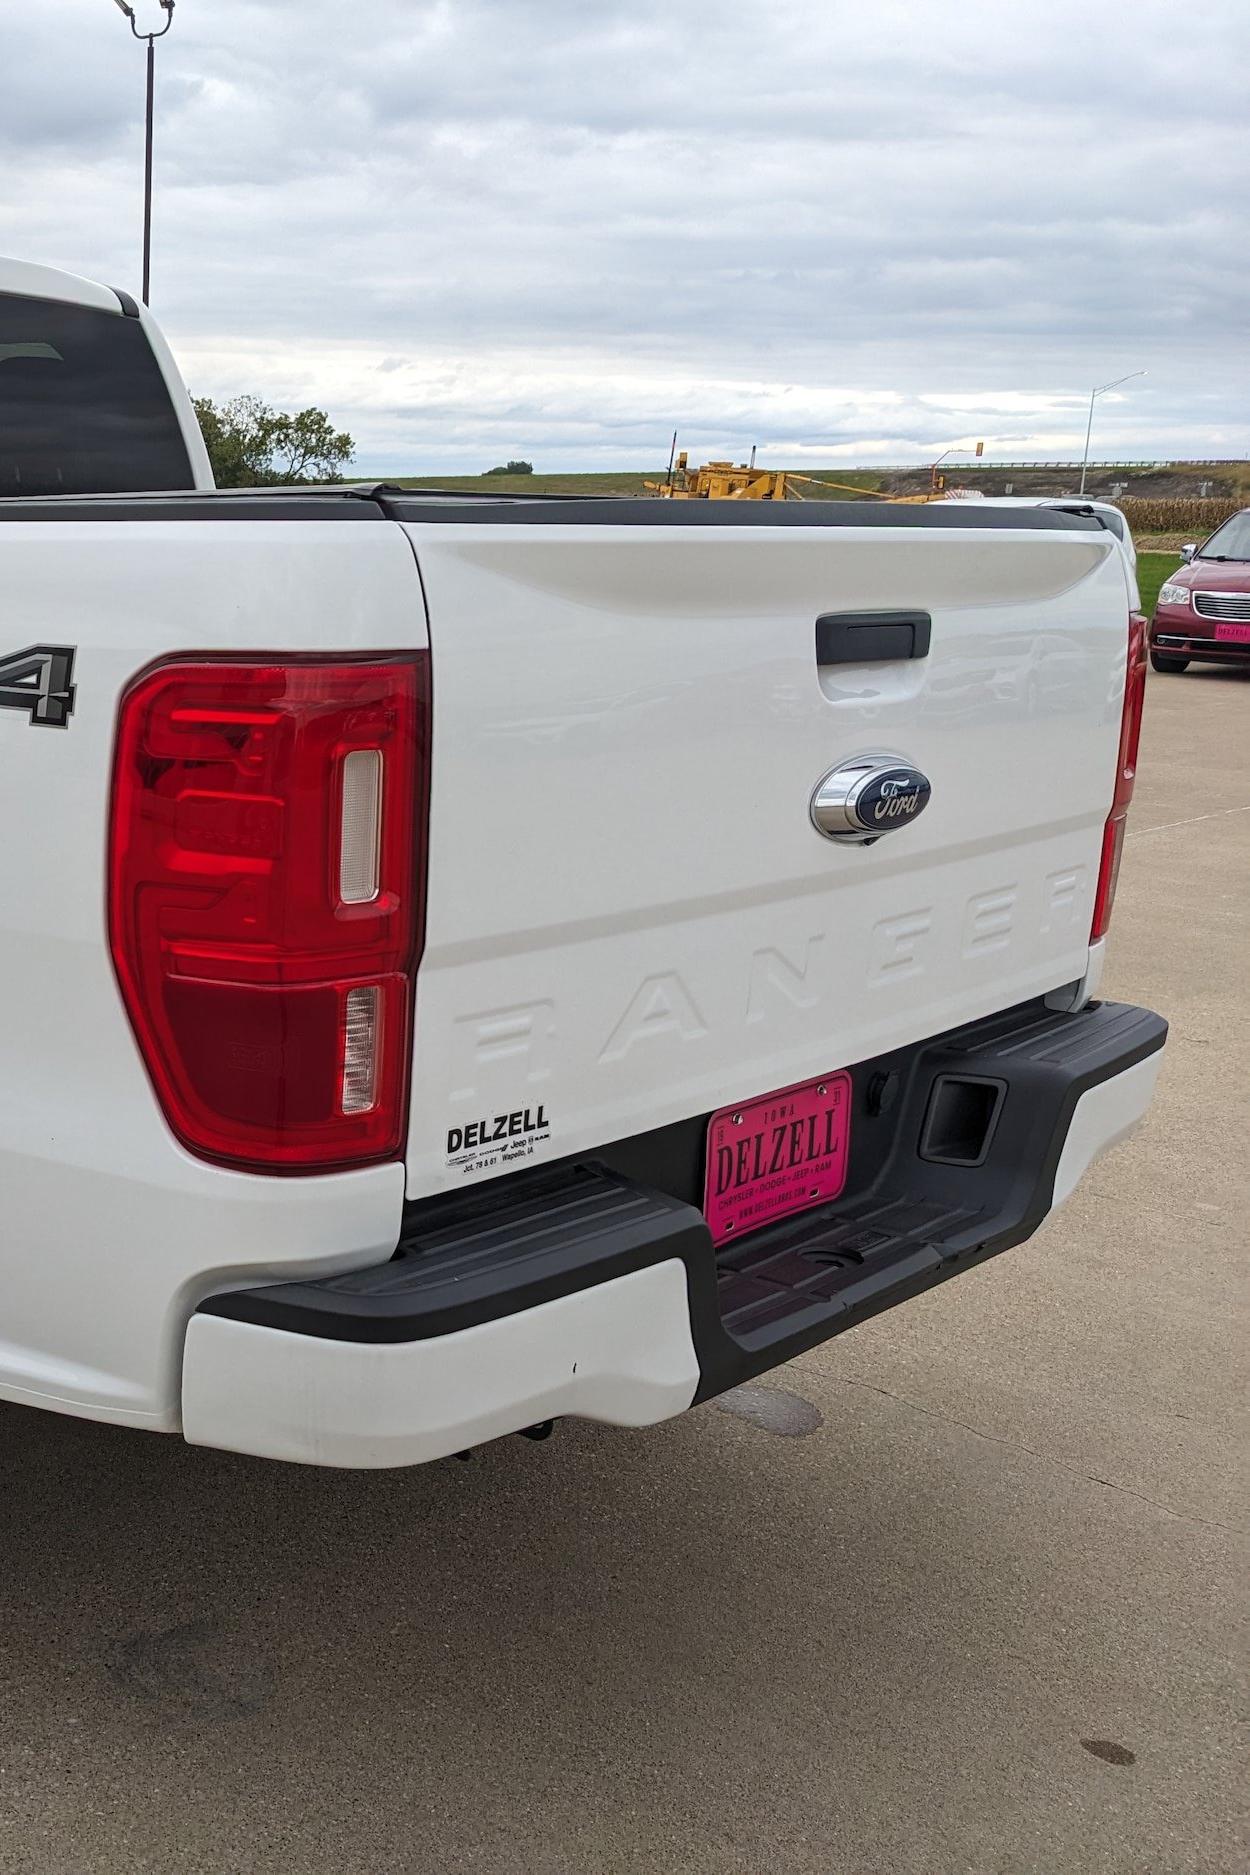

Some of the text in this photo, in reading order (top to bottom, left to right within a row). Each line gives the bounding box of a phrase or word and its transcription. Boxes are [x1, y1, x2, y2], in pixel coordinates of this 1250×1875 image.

[874, 779, 920, 820] Ford
[450, 864, 1086, 1102] RANGER
[447, 1105, 549, 1154] DELZELL
[764, 1104, 795, 1125] IOWA
[510, 1139, 527, 1149] Jeep
[714, 1109, 838, 1197] DELZELL
[718, 1161, 832, 1211] CHRYSLER DODGE JEEP RAM
